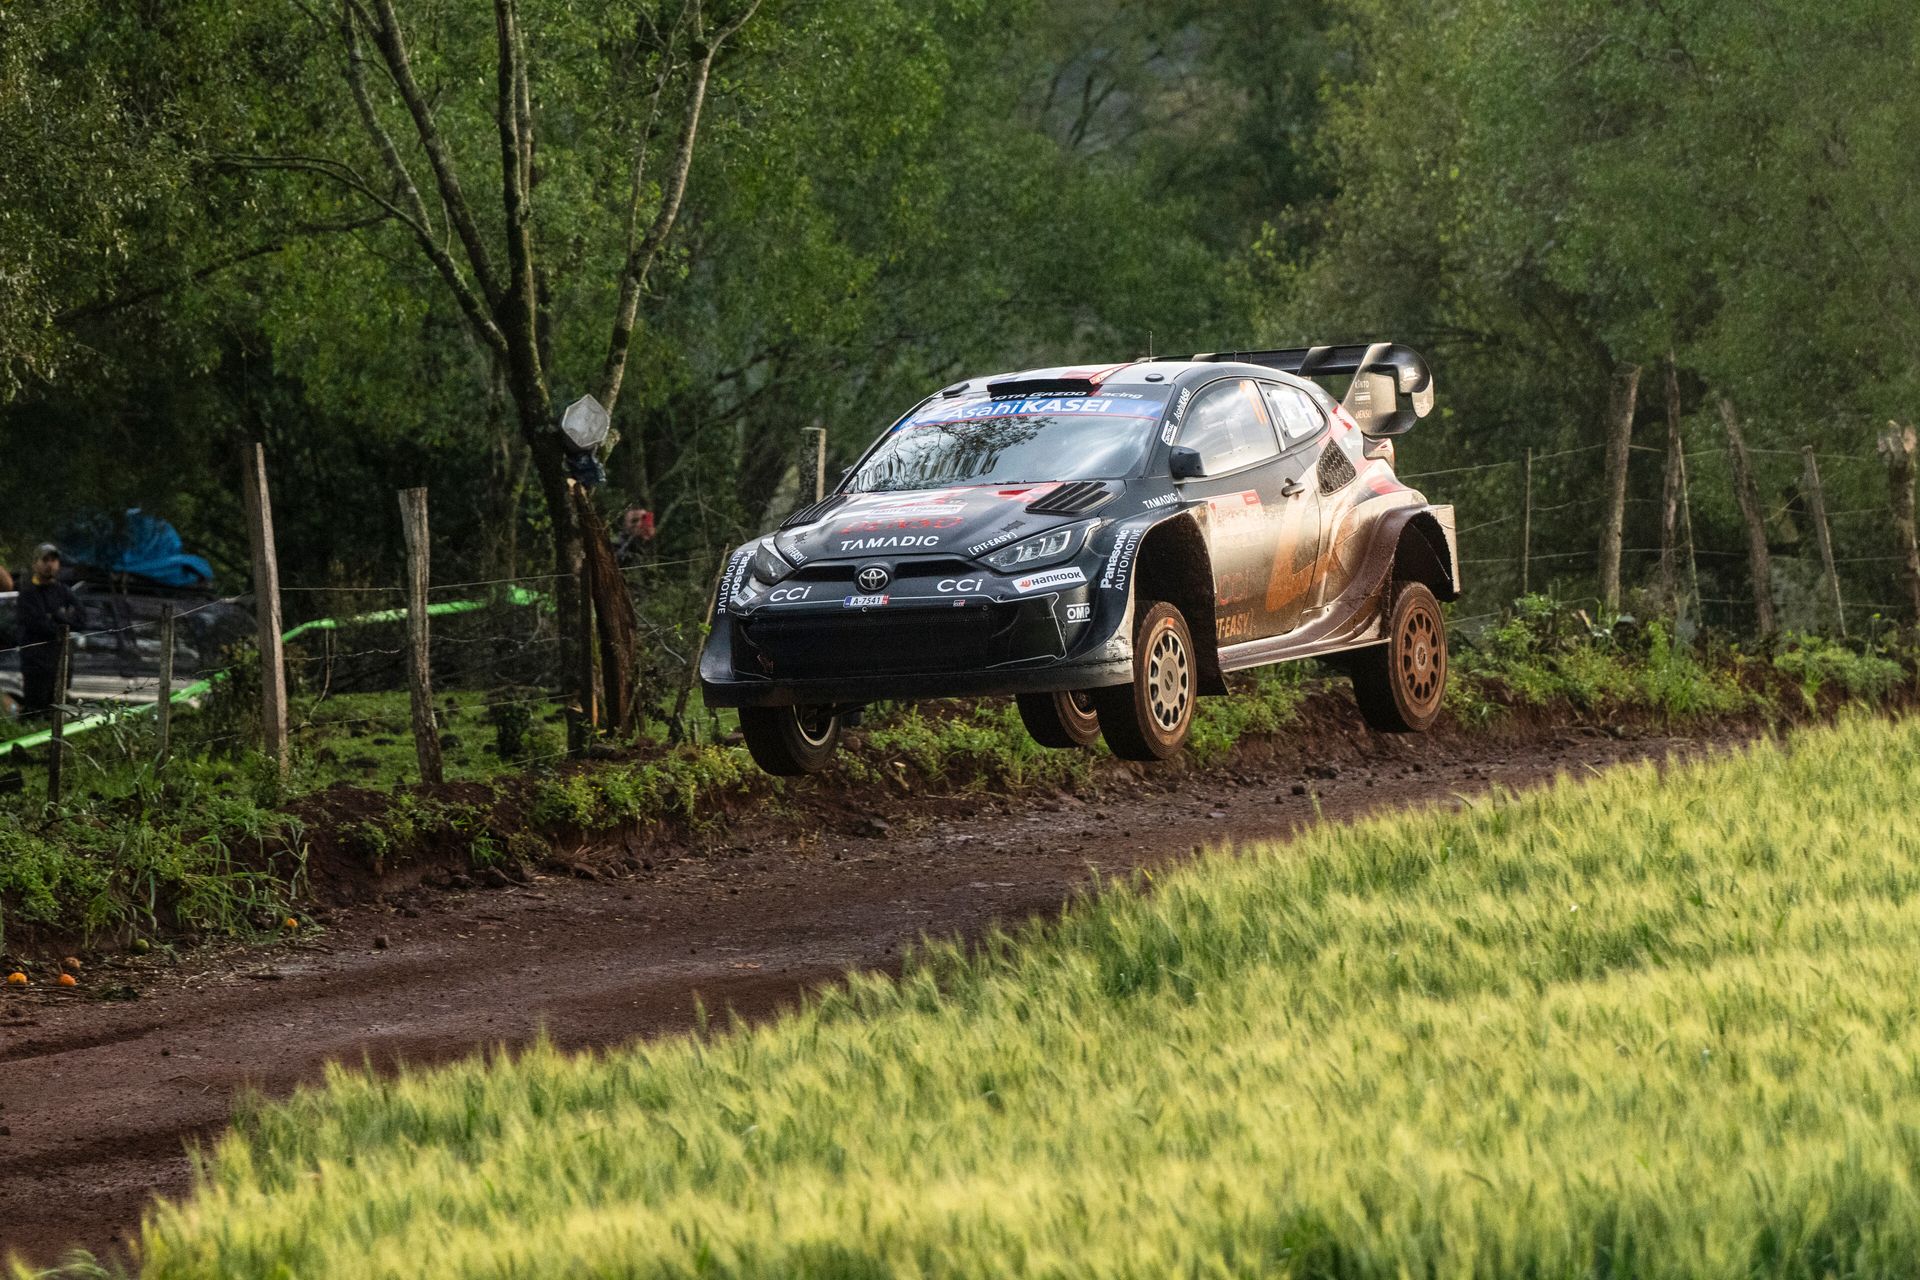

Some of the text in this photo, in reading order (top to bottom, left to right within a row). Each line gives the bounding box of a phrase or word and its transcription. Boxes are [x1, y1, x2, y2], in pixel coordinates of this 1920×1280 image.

[944, 400, 1112, 421] AsahiKASEI
[1142, 492, 1178, 509] TAMADIC
[840, 535, 940, 551] TAMADIC
[1100, 529, 1130, 589] Panasonic
[1114, 528, 1143, 591] AUTOMOTIVE
[717, 551, 744, 615] AUTOMOTIVE
[729, 550, 757, 602] Panason
[852, 596, 881, 605] A-7541
[1066, 606, 1091, 620] OMP
